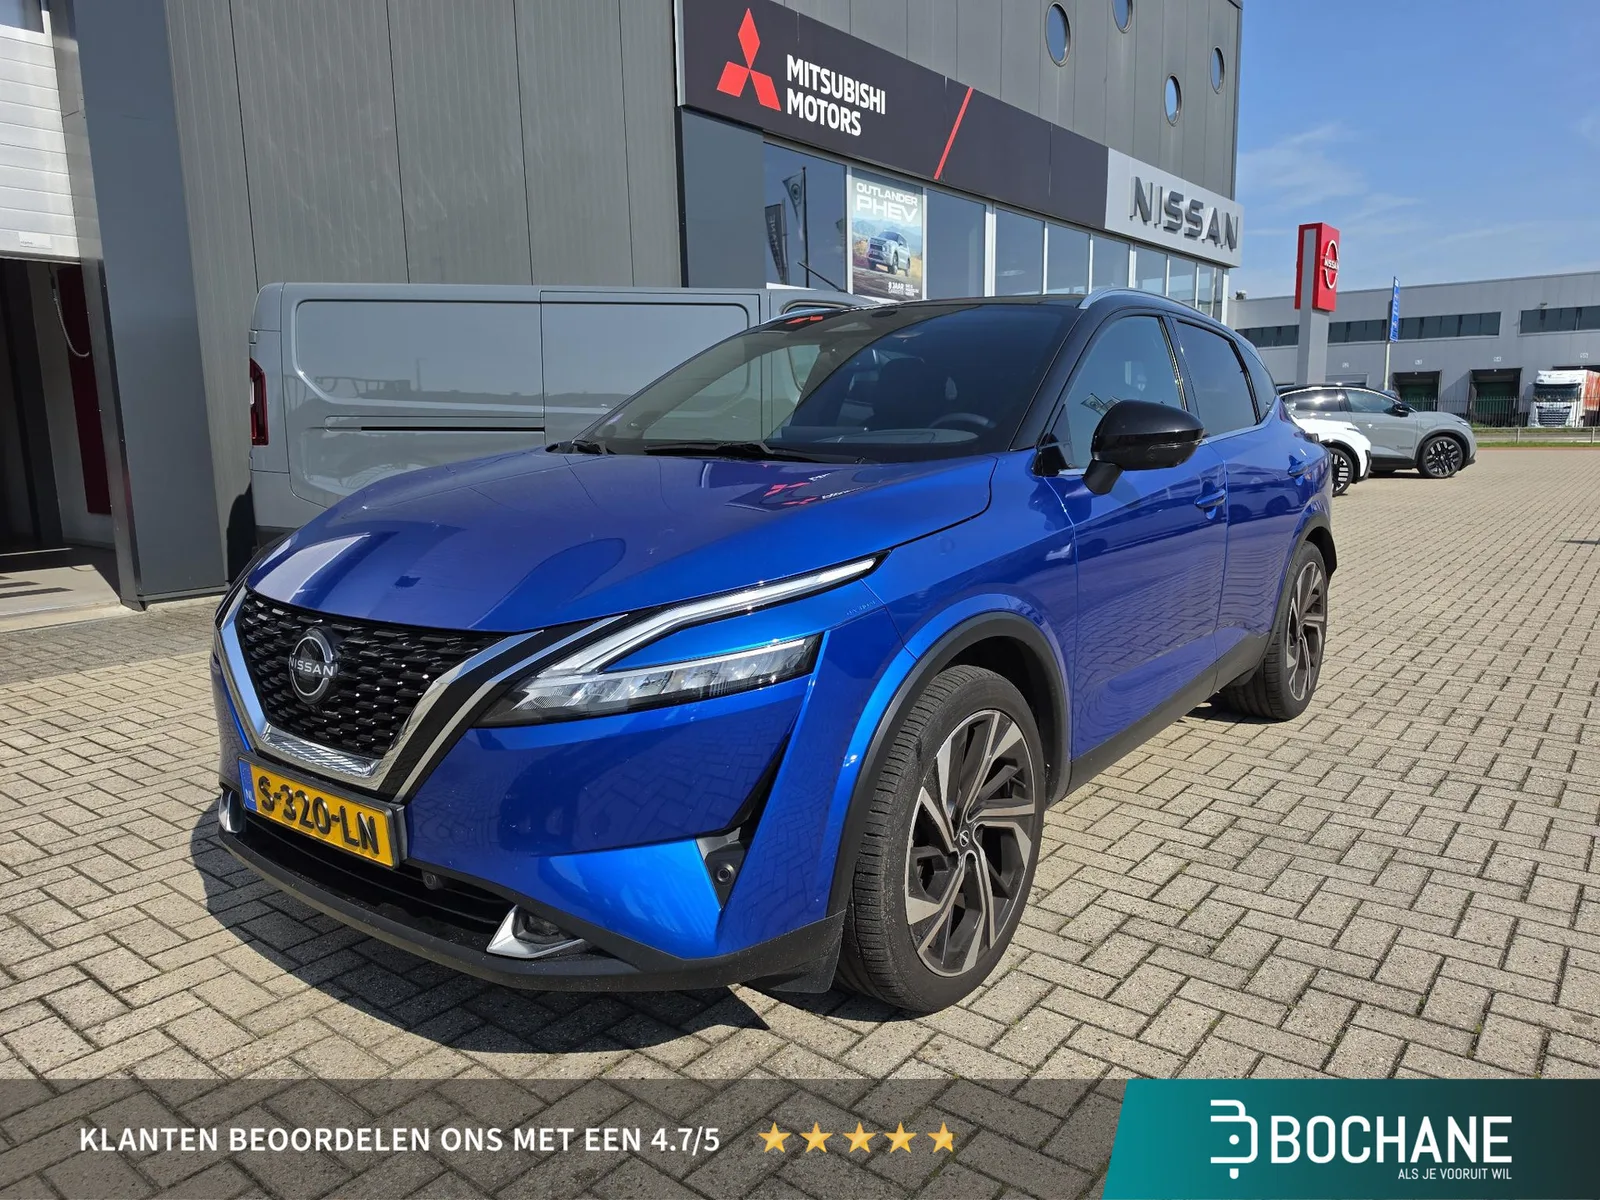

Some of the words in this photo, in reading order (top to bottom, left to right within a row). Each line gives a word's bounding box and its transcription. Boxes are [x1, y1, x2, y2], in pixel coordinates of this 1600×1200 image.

[786, 54, 886, 115] MITSUBISHI
[786, 88, 862, 137] MOTORS
[856, 182, 918, 207] OUTLANDER
[856, 194, 918, 223] PHEV
[1130, 176, 1239, 250] NISSAN
[289, 656, 335, 677] NISSAN
[257, 775, 380, 856] S-320-LN
